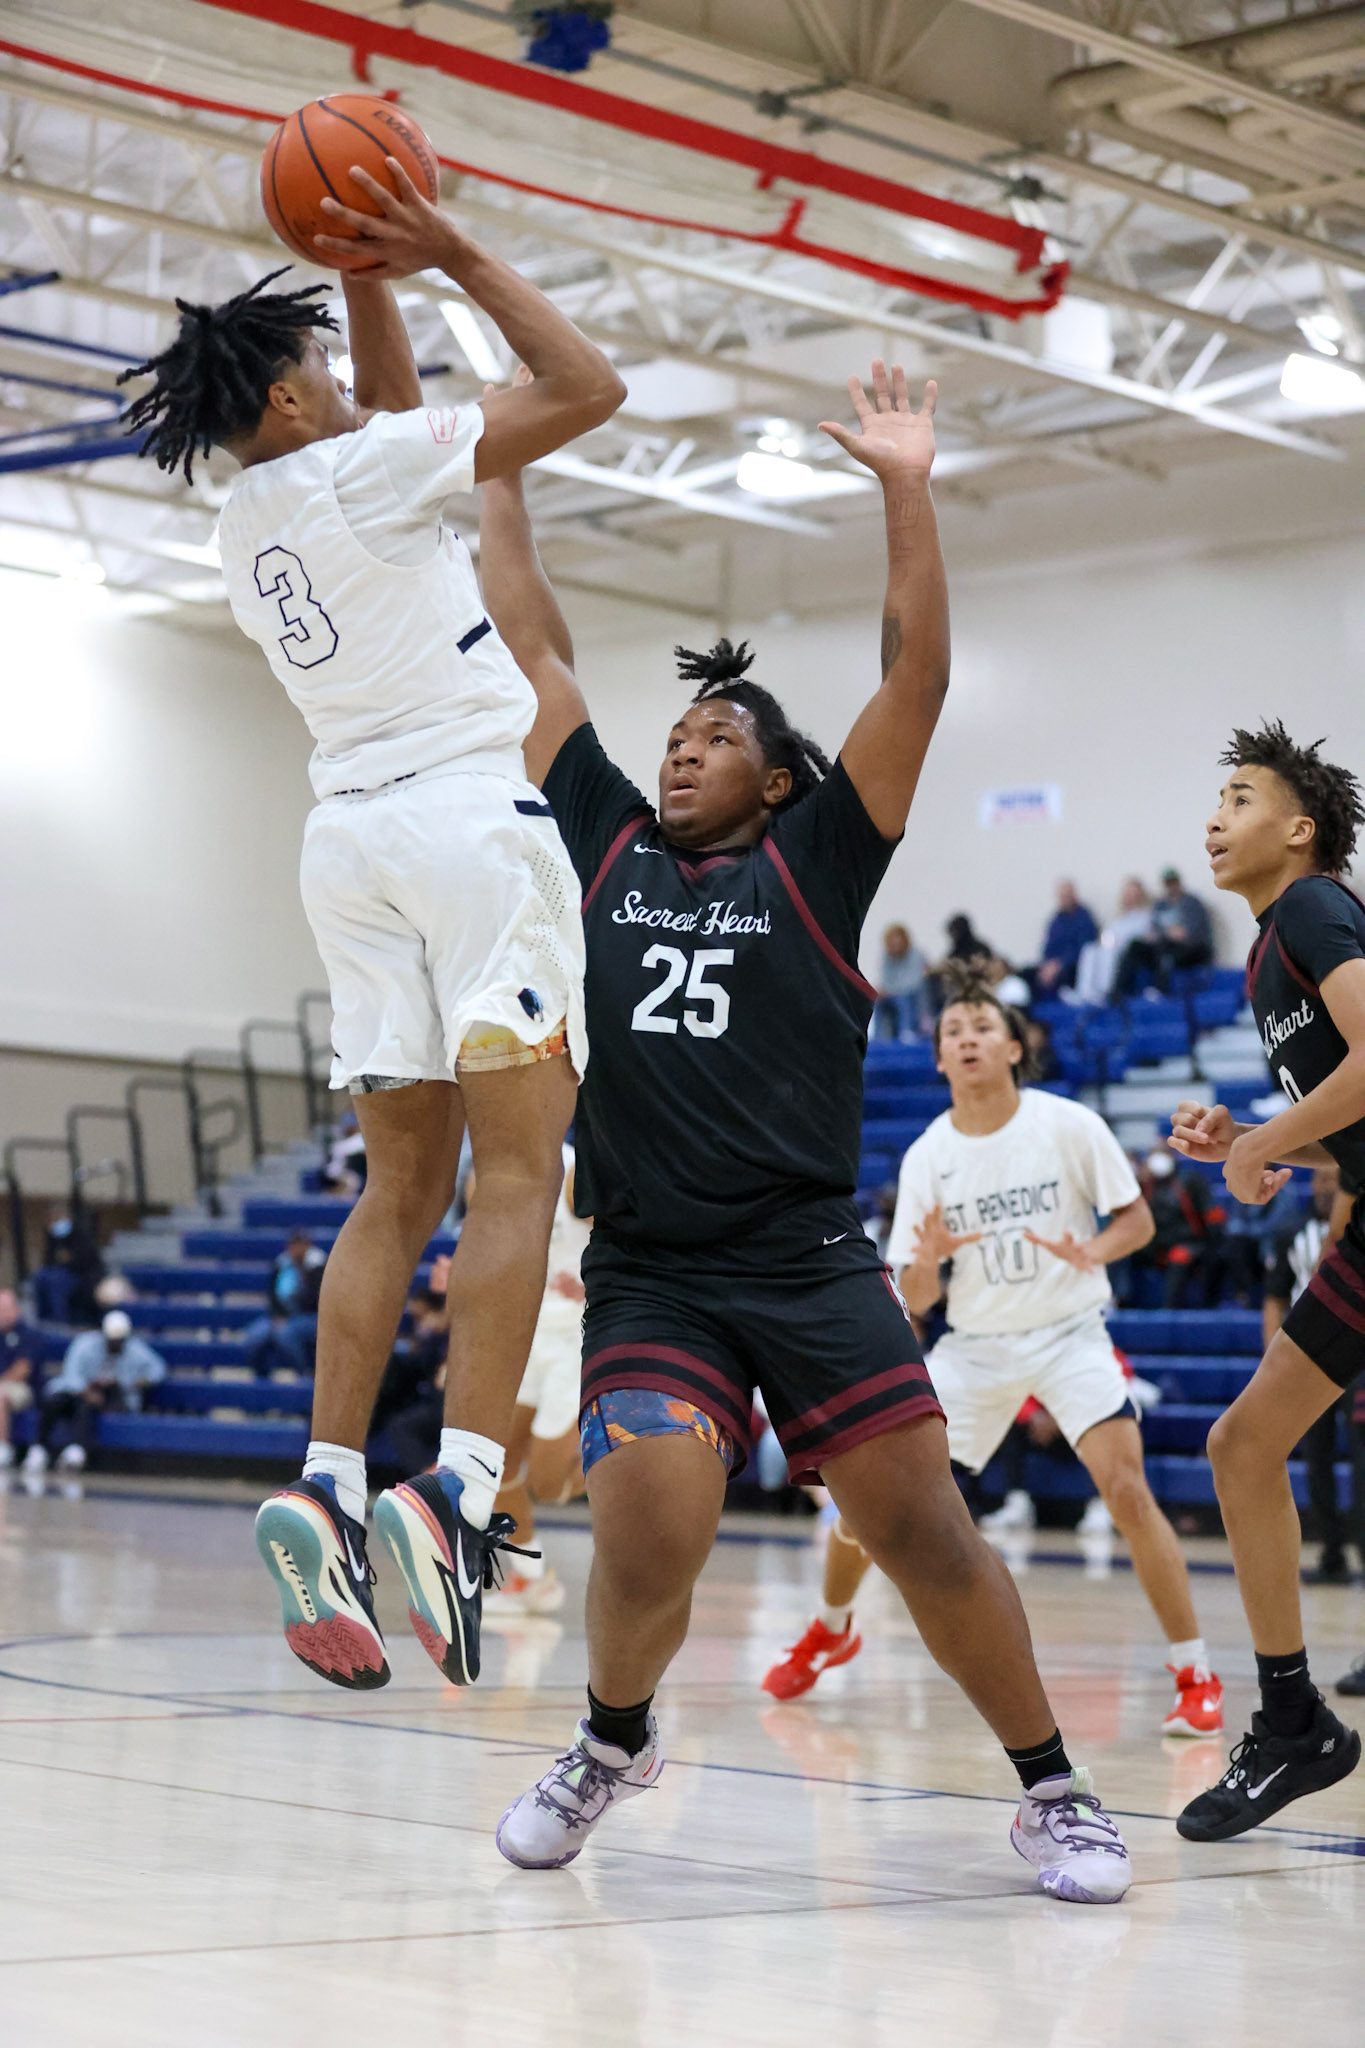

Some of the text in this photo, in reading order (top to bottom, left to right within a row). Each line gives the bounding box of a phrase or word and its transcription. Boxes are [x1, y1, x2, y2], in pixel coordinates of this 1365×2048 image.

[253, 545, 339, 670] 3
[611, 890, 772, 935] Sacred Heart
[631, 943, 735, 1039] 25
[1267, 998, 1315, 1050] Heart
[978, 1226, 1038, 1286] 10
